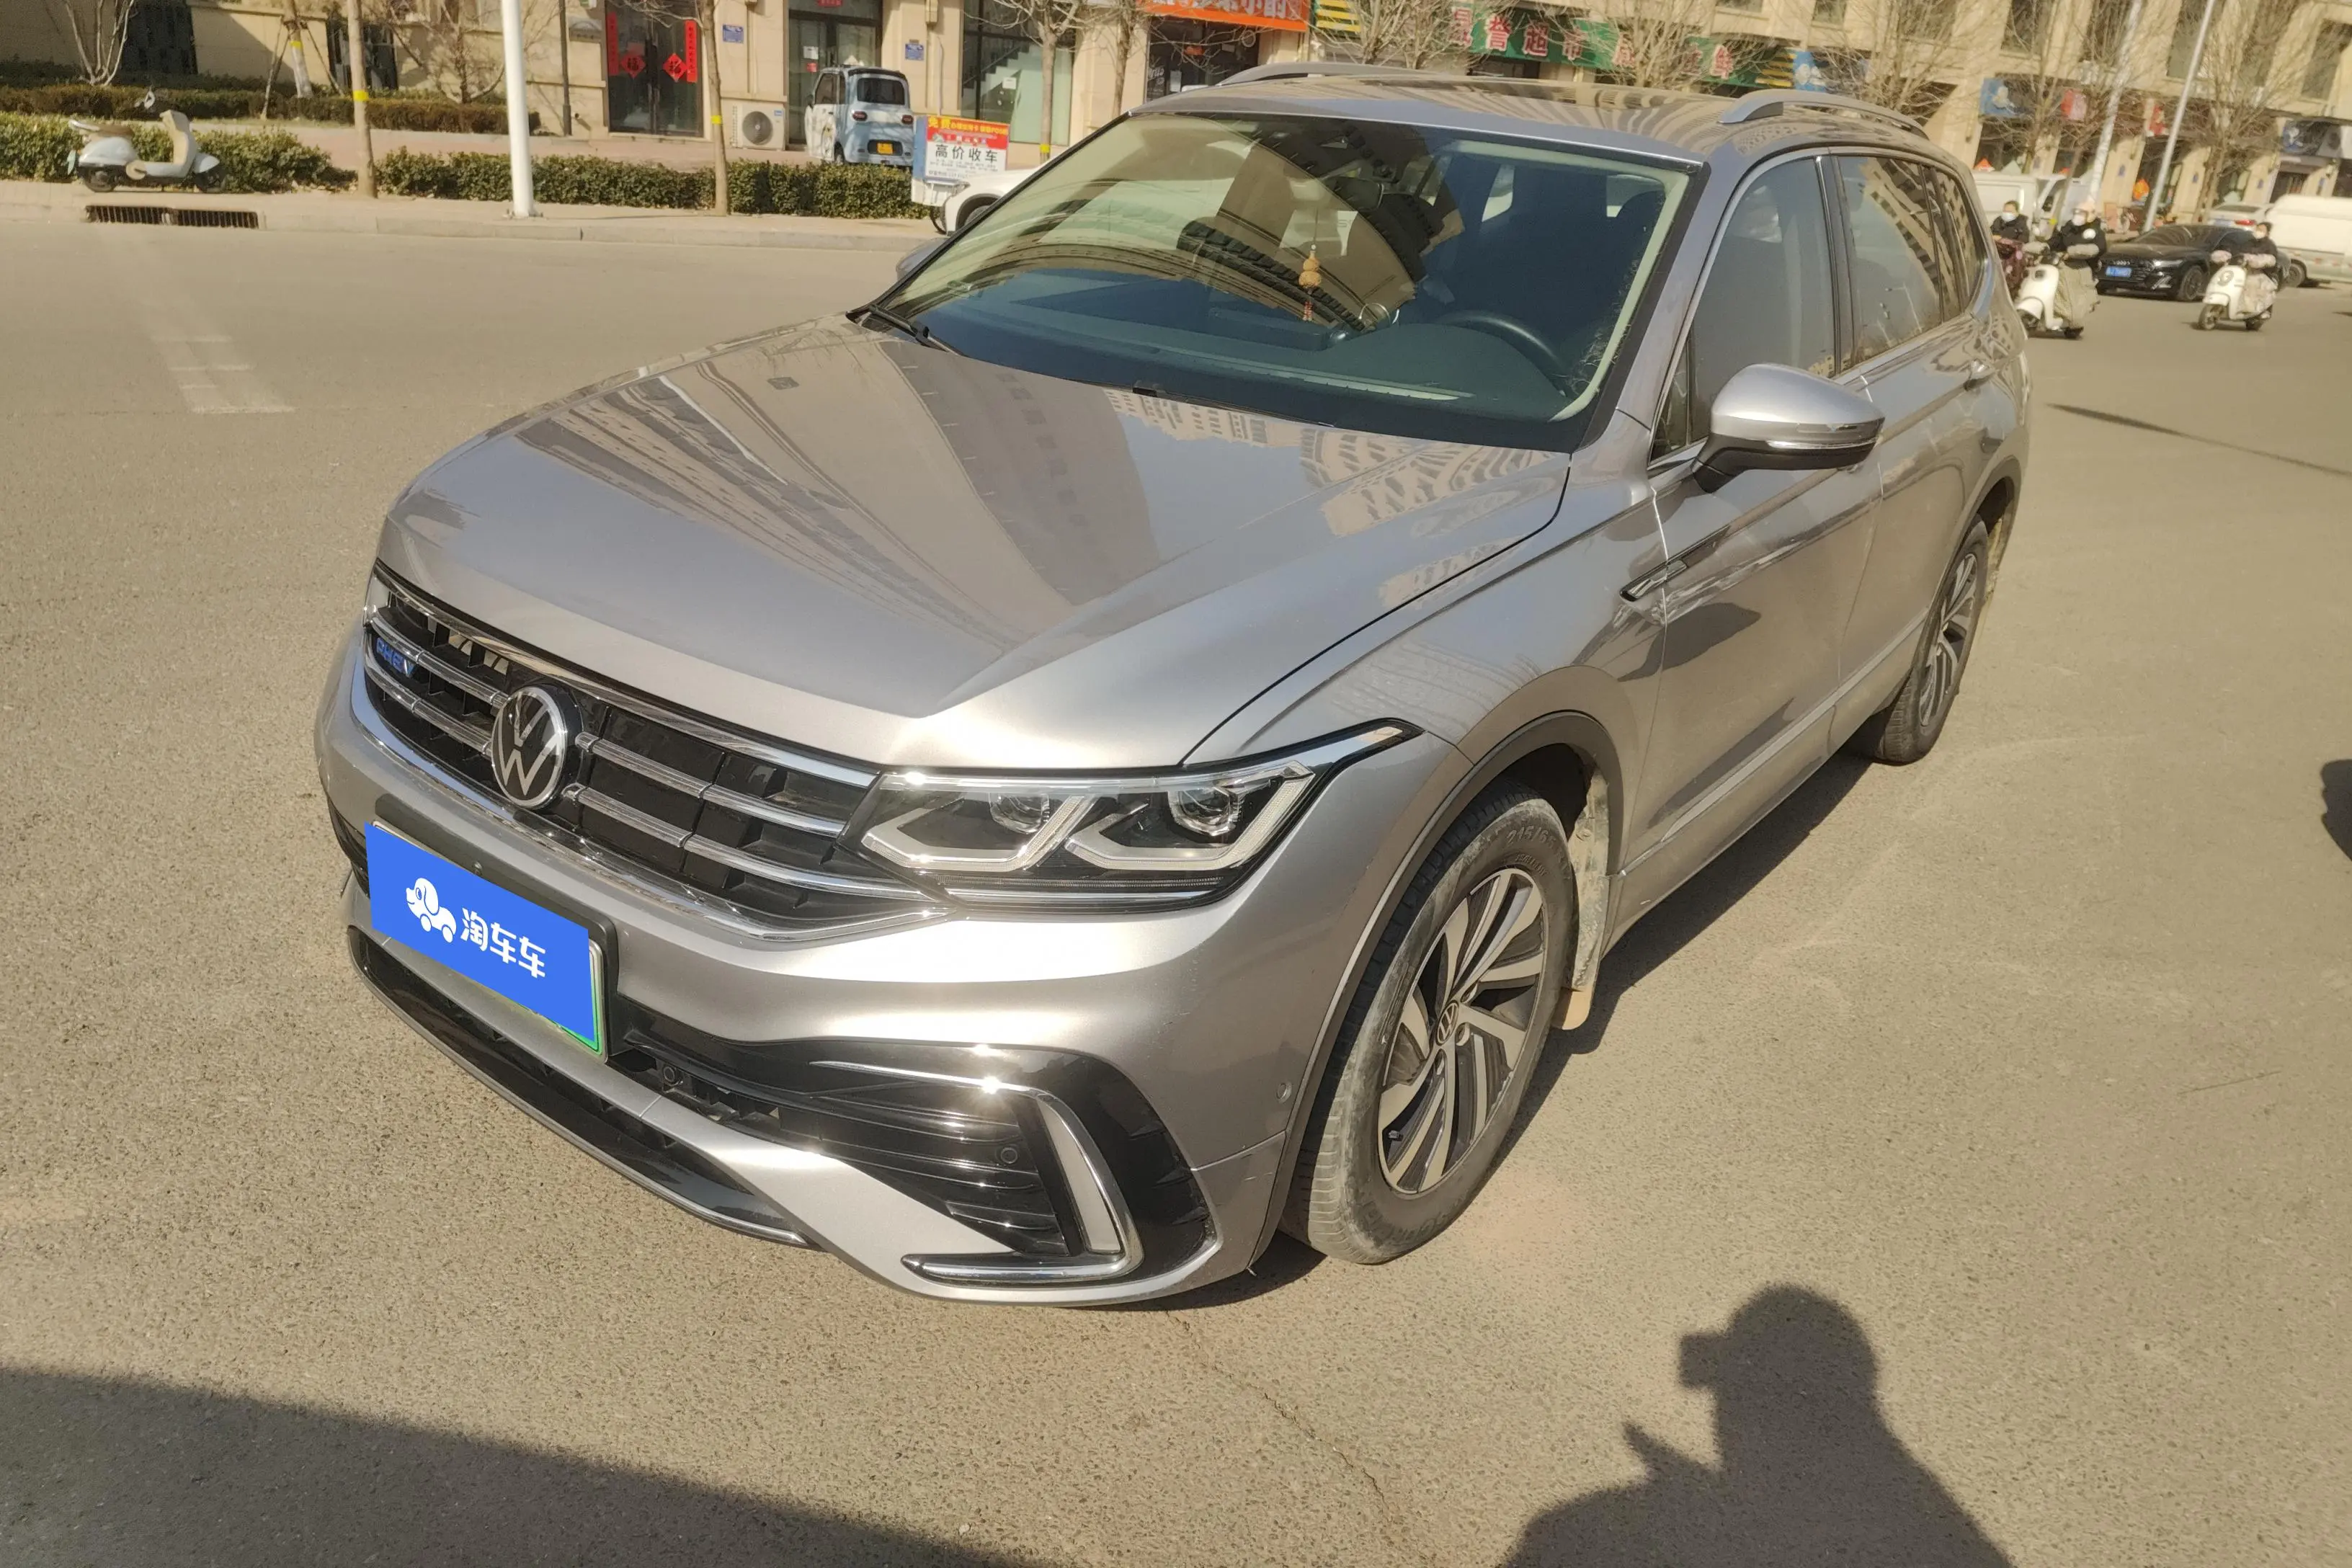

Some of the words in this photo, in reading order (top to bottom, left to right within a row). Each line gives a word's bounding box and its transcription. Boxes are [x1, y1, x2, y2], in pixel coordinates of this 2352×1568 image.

[935, 144, 998, 164] 高价收车
[376, 637, 416, 677] PHEV
